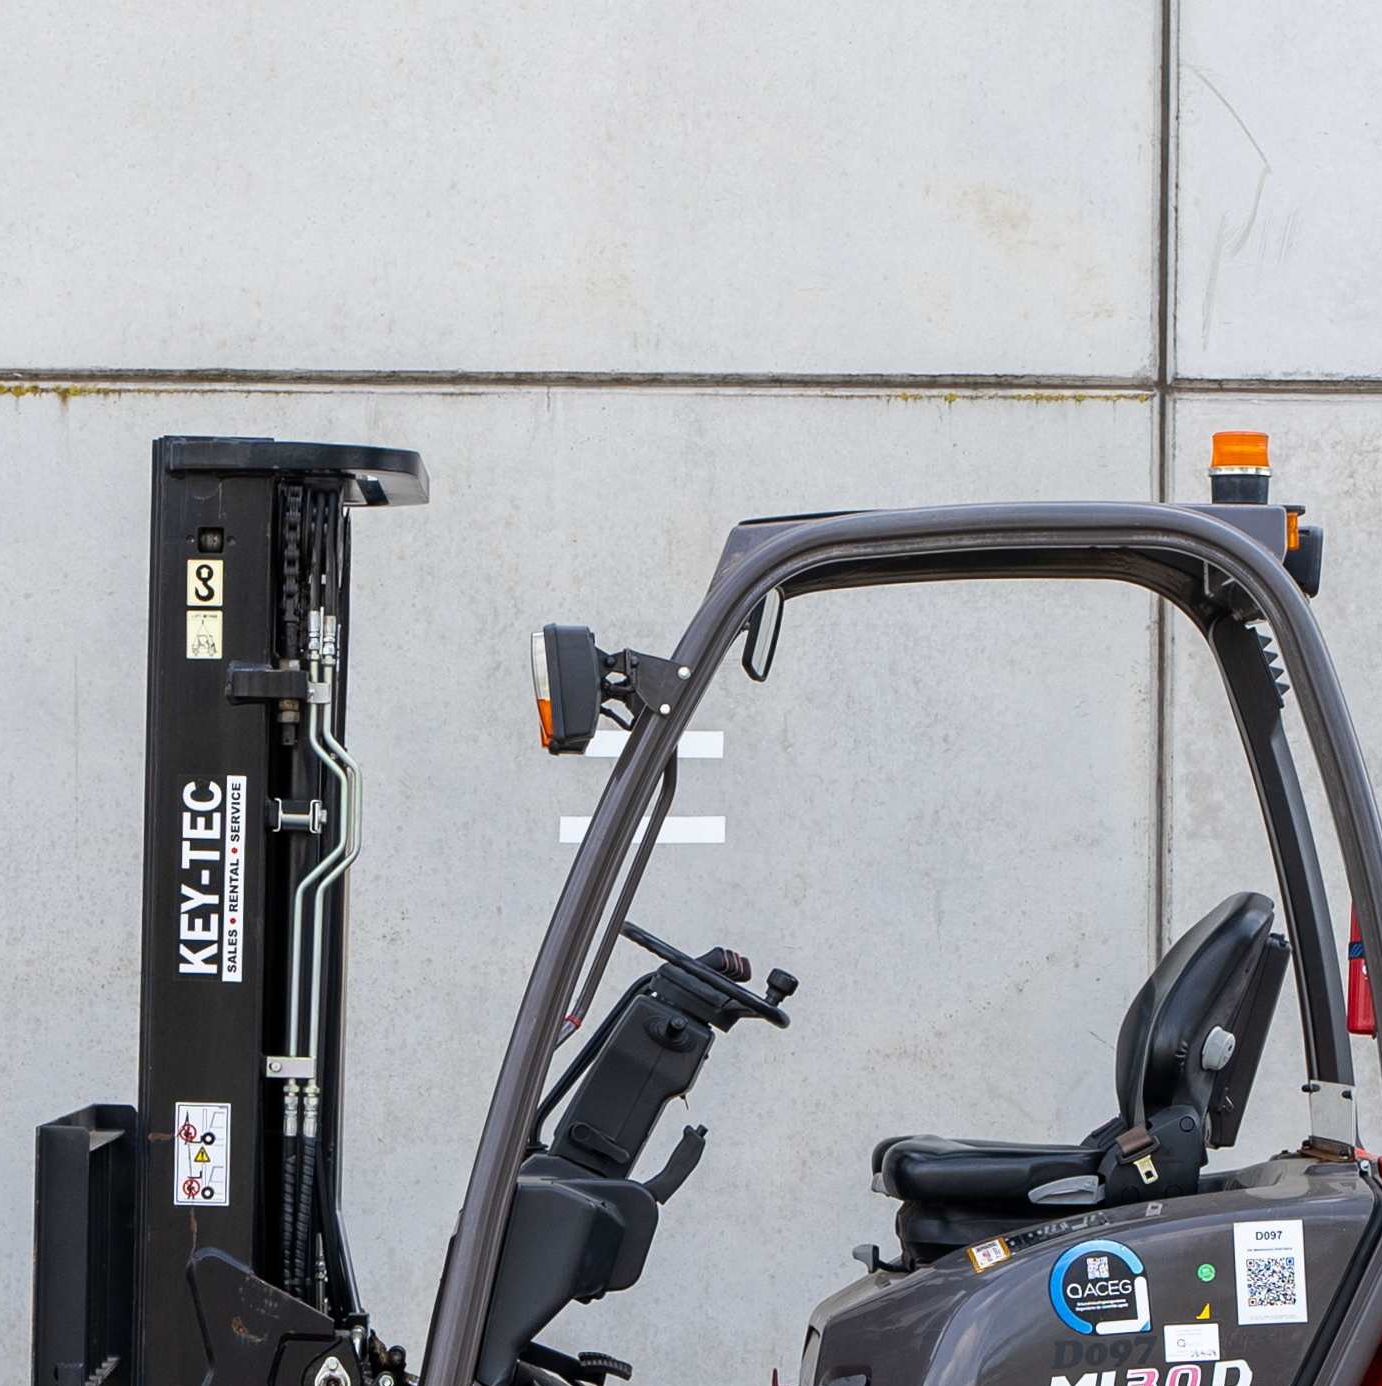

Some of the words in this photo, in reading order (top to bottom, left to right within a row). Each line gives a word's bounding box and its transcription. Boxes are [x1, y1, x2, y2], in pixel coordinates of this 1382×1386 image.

[230, 782, 242, 842] SERVICE
[179, 780, 223, 974] KEY-TEC
[229, 858, 240, 912] RENTAL
[227, 928, 238, 973] SALES
[1255, 1230, 1283, 1241] D097
